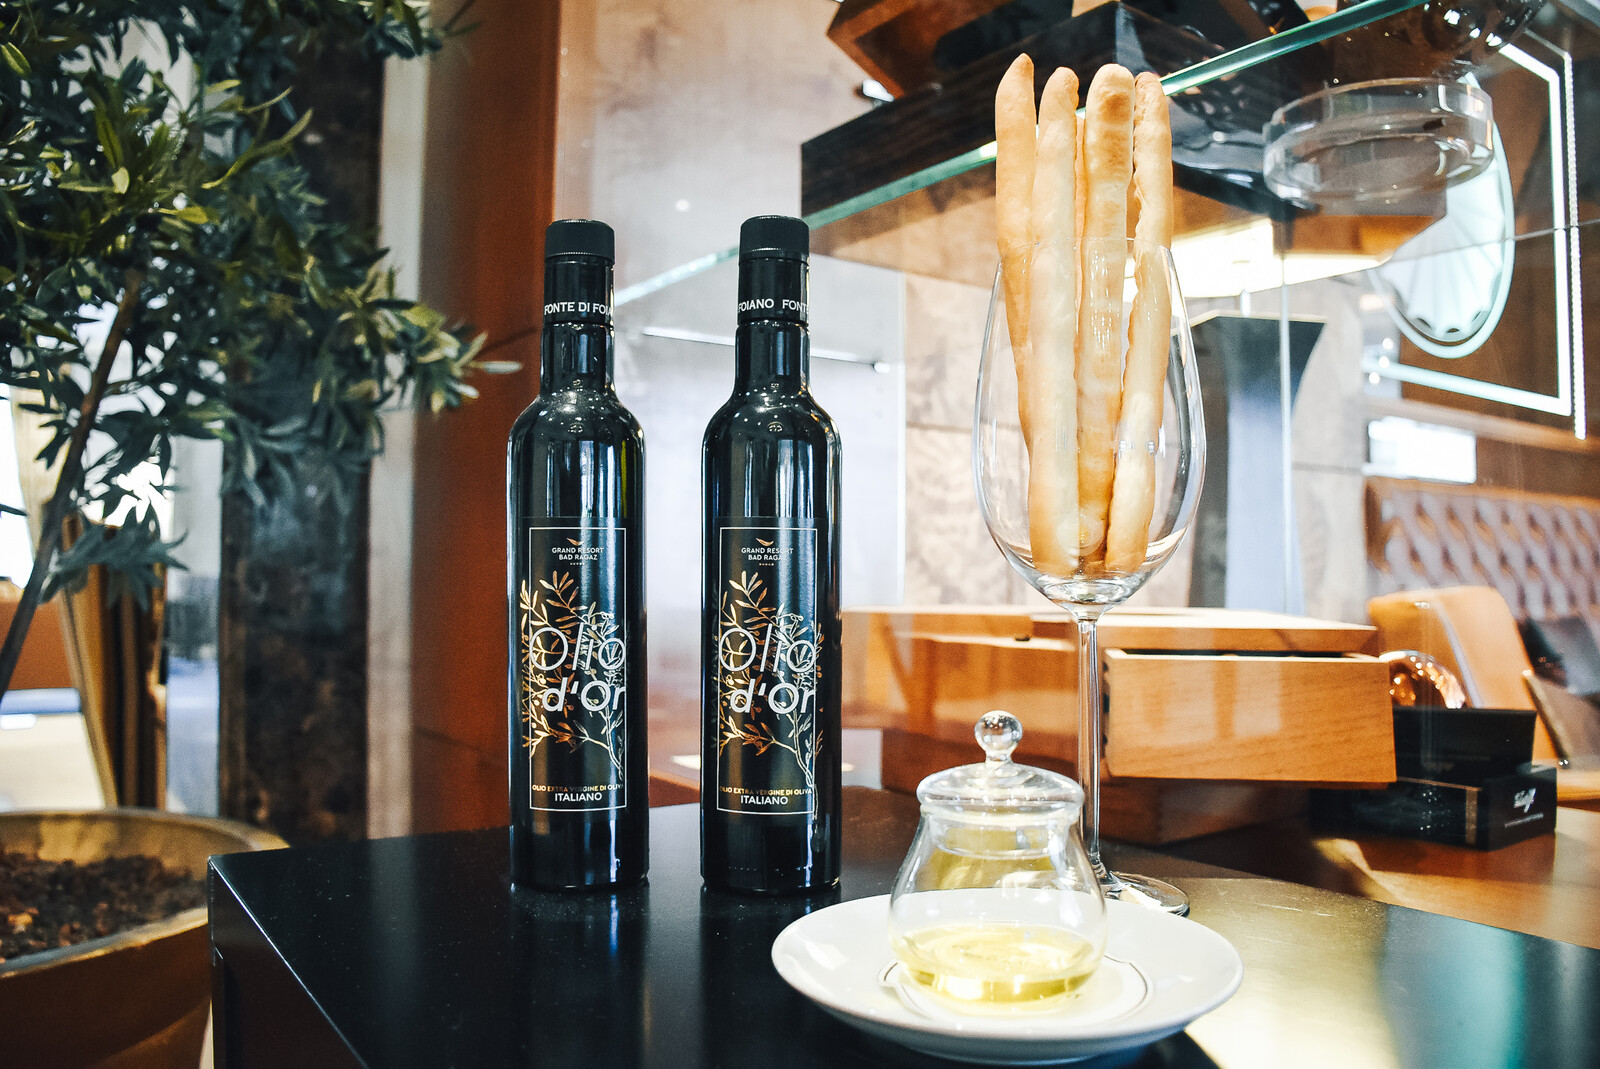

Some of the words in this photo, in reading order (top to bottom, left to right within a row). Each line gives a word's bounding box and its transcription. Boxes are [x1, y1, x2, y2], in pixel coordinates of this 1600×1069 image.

[543, 301, 575, 315] FONTE
[578, 301, 590, 313] DI
[529, 621, 626, 671] Olio
[719, 623, 816, 673] Olio
[542, 677, 626, 712] d'Or
[730, 678, 816, 714] d'Or
[532, 784, 546, 792] OLIO
[733, 787, 754, 795] EXTRA
[554, 792, 602, 802] ITALIANO
[740, 795, 789, 805] ITALIANO
